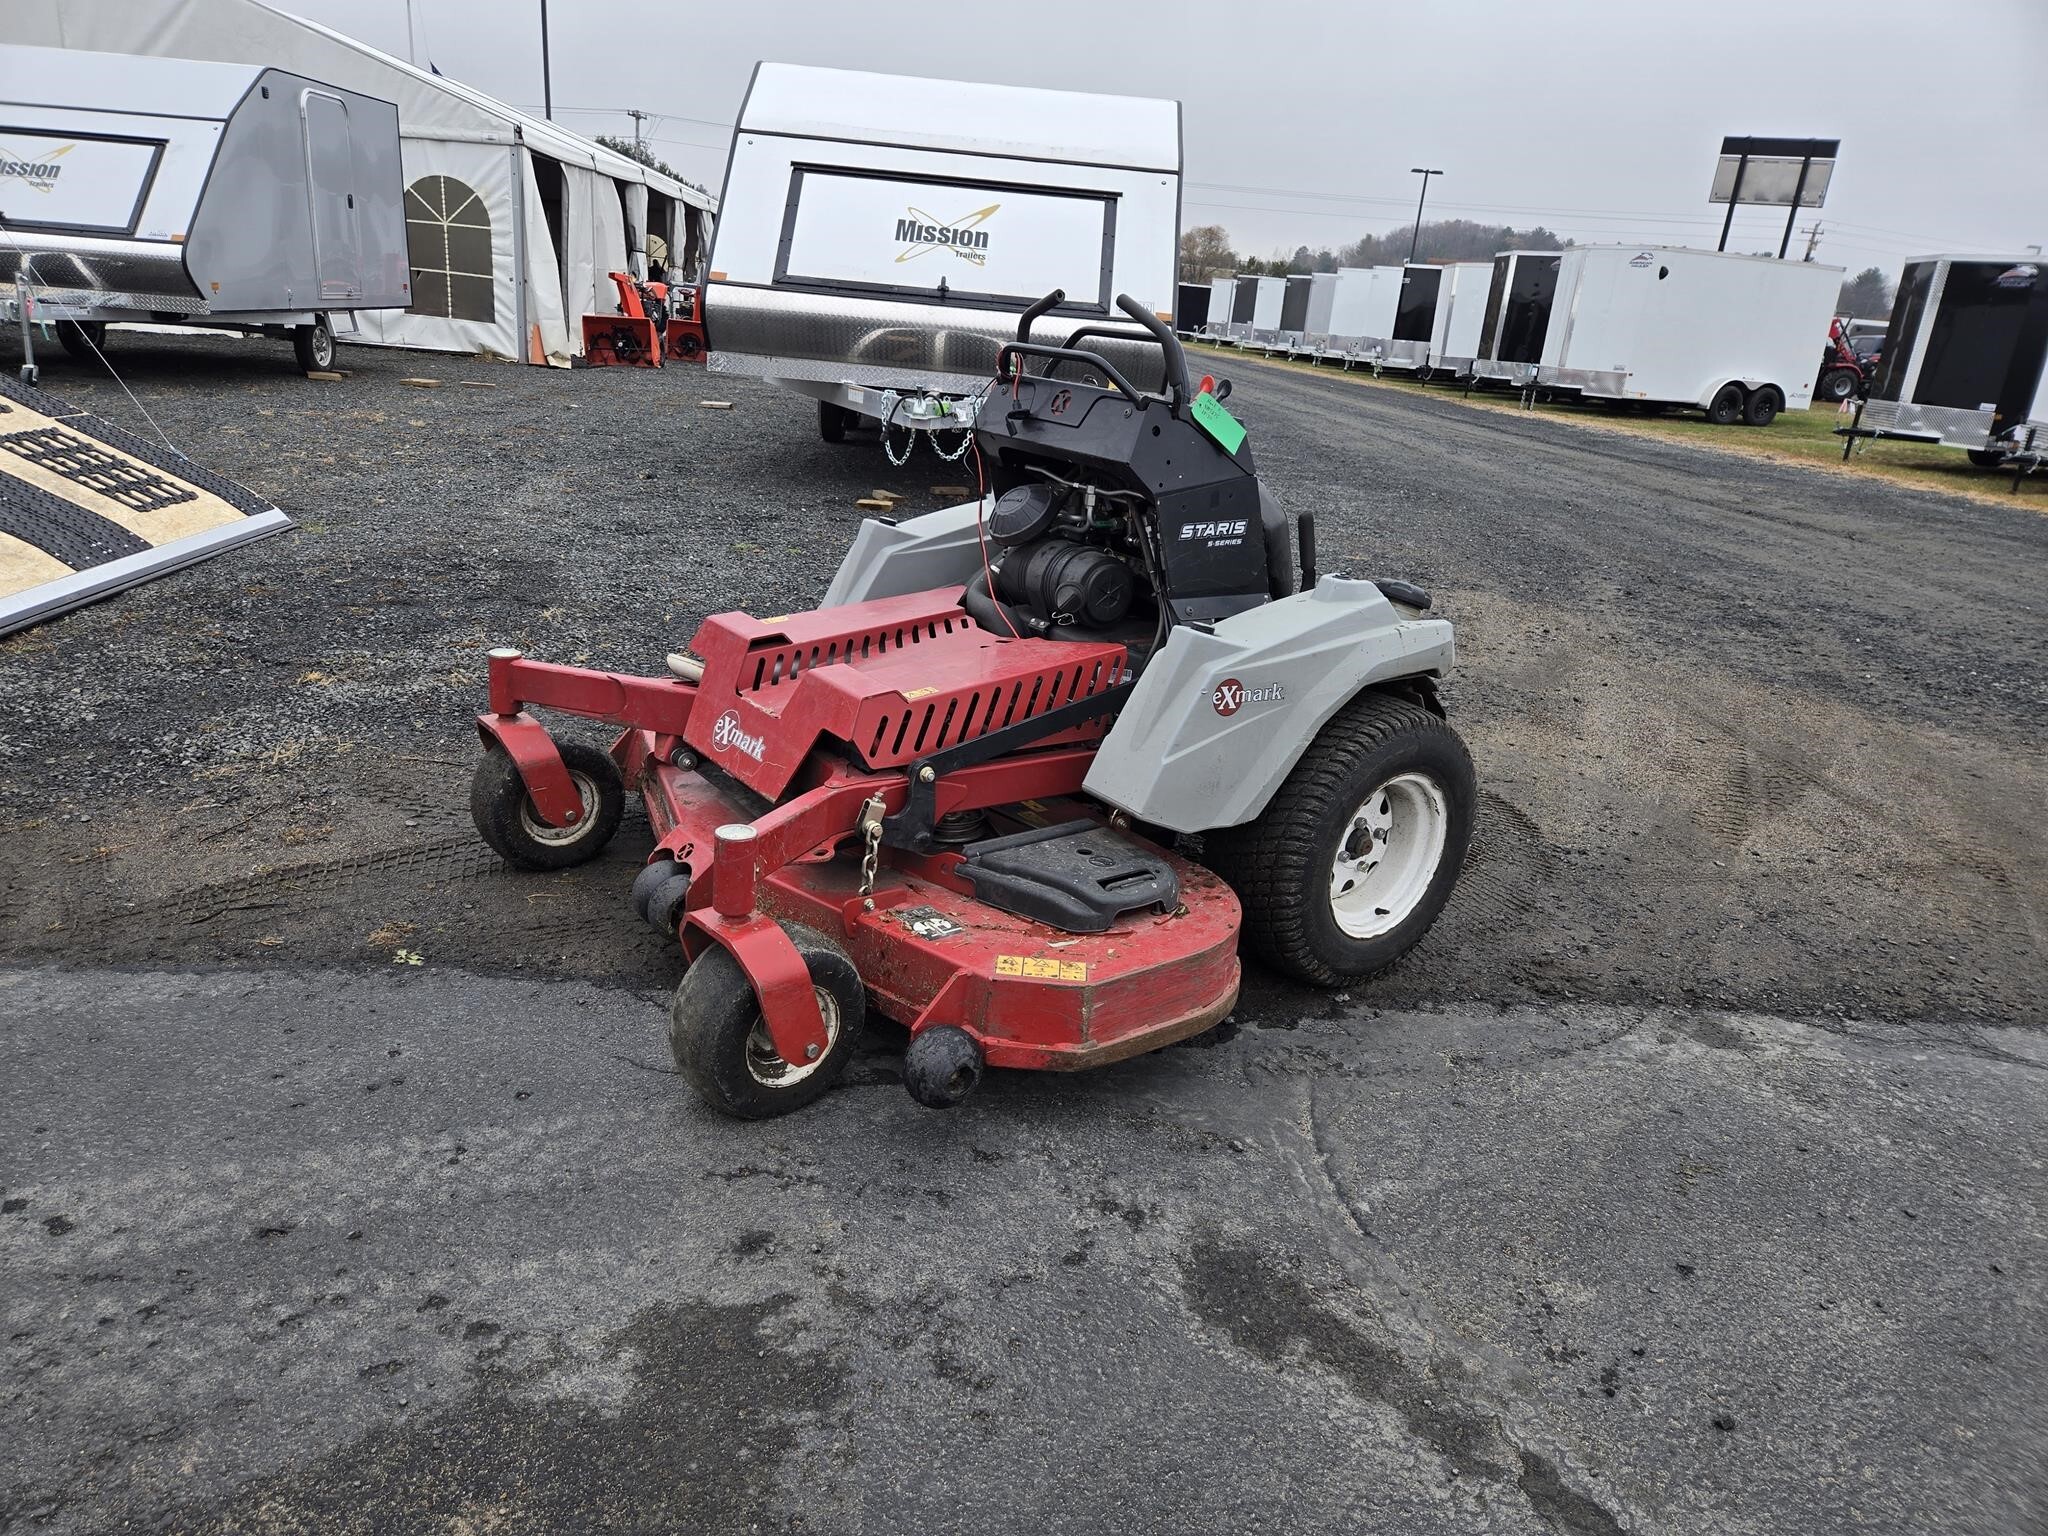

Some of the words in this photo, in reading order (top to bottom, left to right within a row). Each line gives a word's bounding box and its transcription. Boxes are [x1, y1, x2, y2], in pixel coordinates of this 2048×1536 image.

[0, 158, 61, 178] ission
[895, 218, 989, 248] Mission
[955, 250, 986, 261] Trailers
[1180, 520, 1247, 539] STARIS
[1212, 683, 1283, 710] eXmark
[715, 715, 766, 762] eXmark
